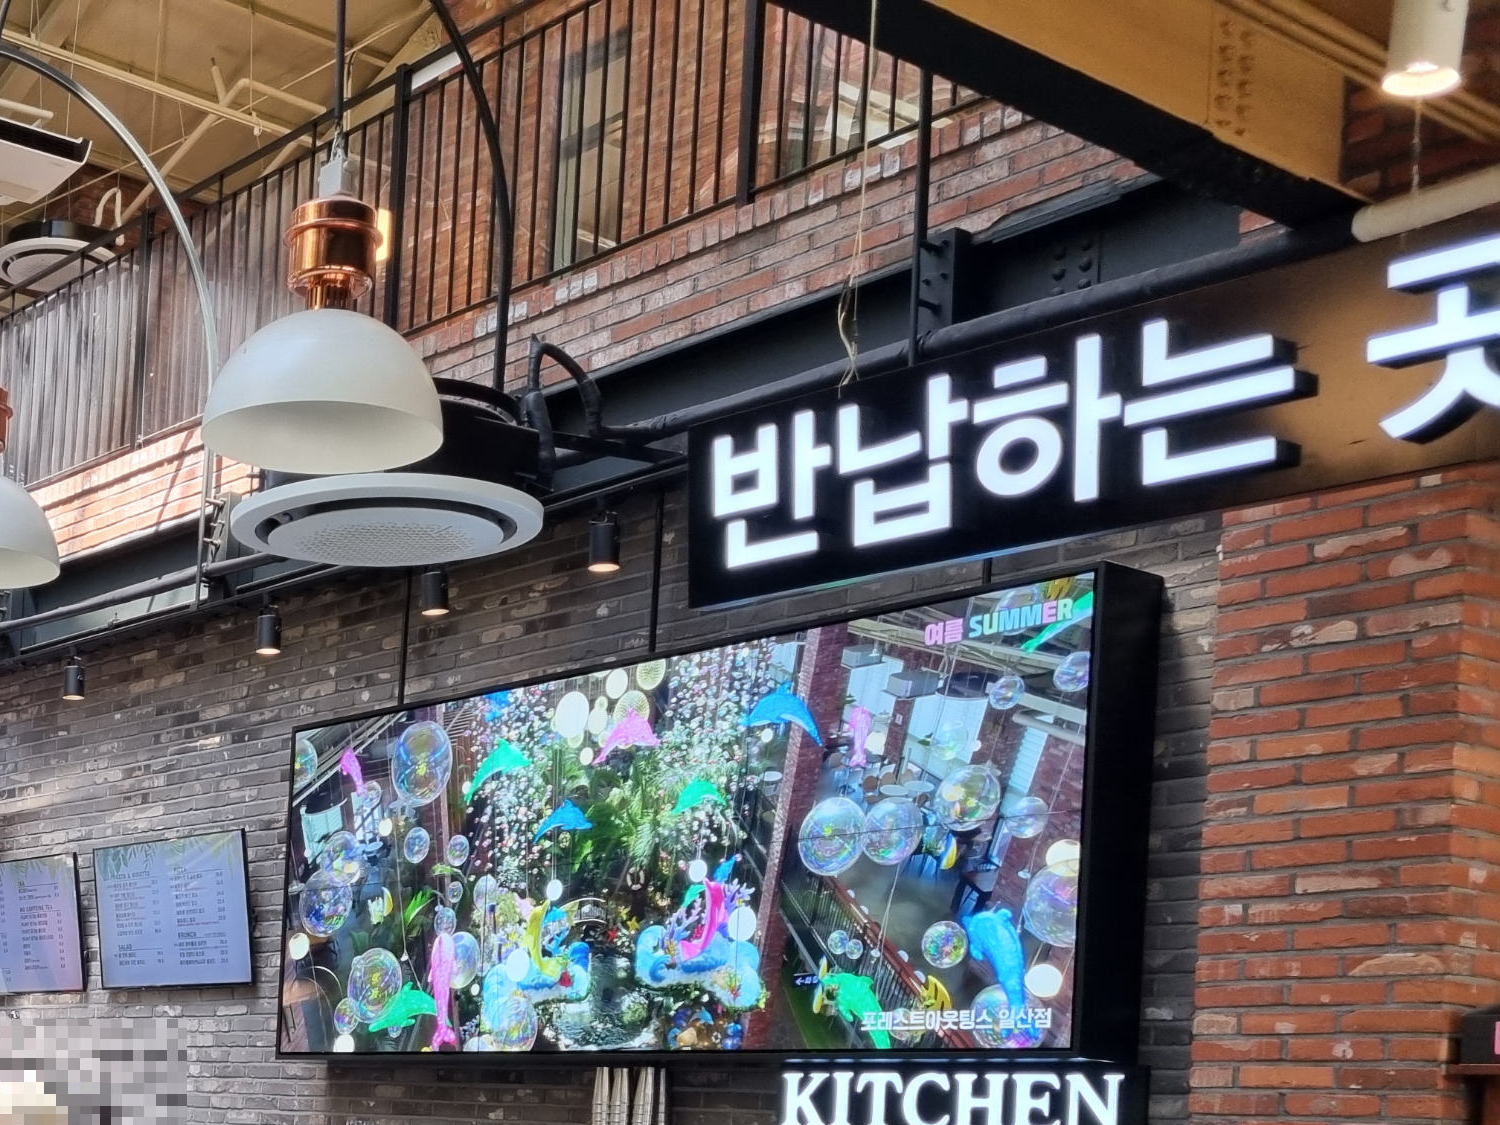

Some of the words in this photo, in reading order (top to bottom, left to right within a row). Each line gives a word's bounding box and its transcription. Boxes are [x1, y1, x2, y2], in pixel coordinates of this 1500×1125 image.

[712, 319, 1295, 569] 반납하는
[924, 618, 964, 646] 여름
[968, 598, 1074, 639] SUMMER
[861, 1010, 993, 1032] 포레스트아웃팅스
[999, 1007, 1052, 1030] 일산점
